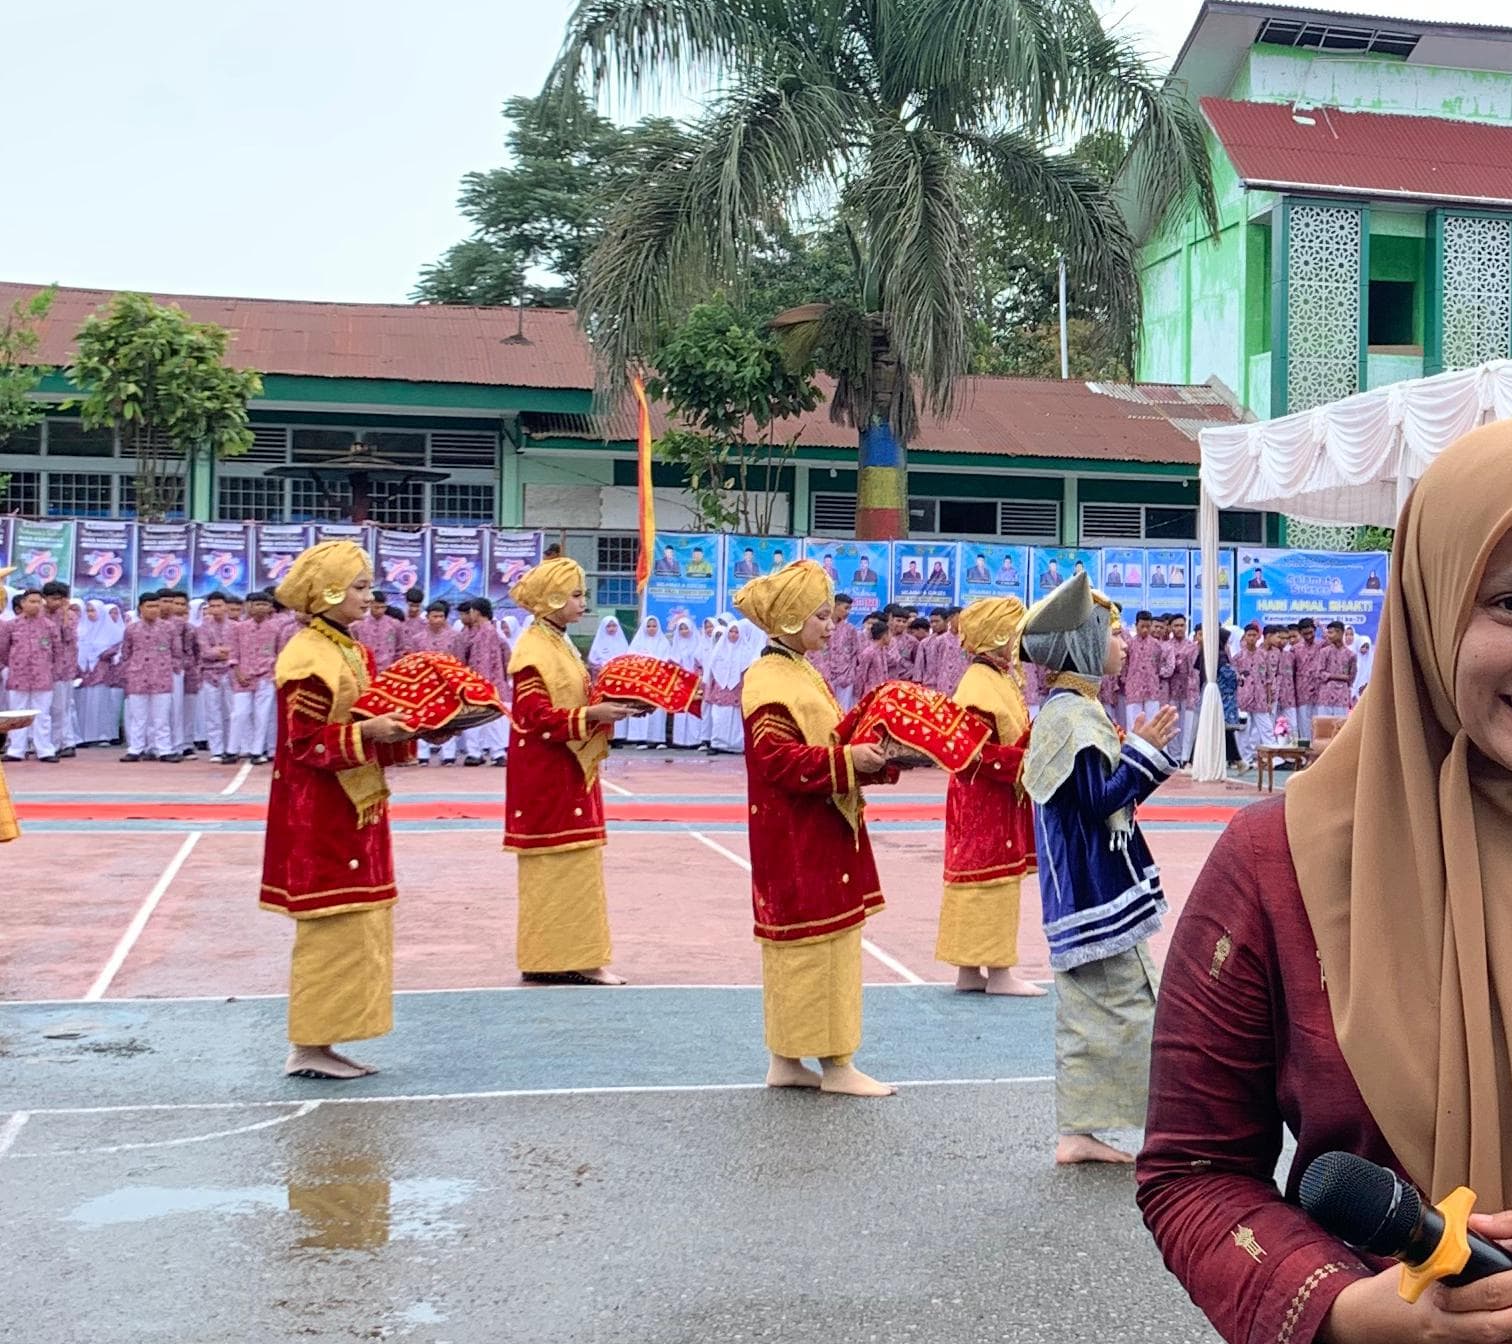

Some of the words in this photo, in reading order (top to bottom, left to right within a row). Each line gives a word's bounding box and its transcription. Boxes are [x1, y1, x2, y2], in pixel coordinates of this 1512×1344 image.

[1256, 599, 1287, 611] HARI
[1290, 600, 1327, 612] AMAL
[1328, 600, 1374, 612] BHAKTI
